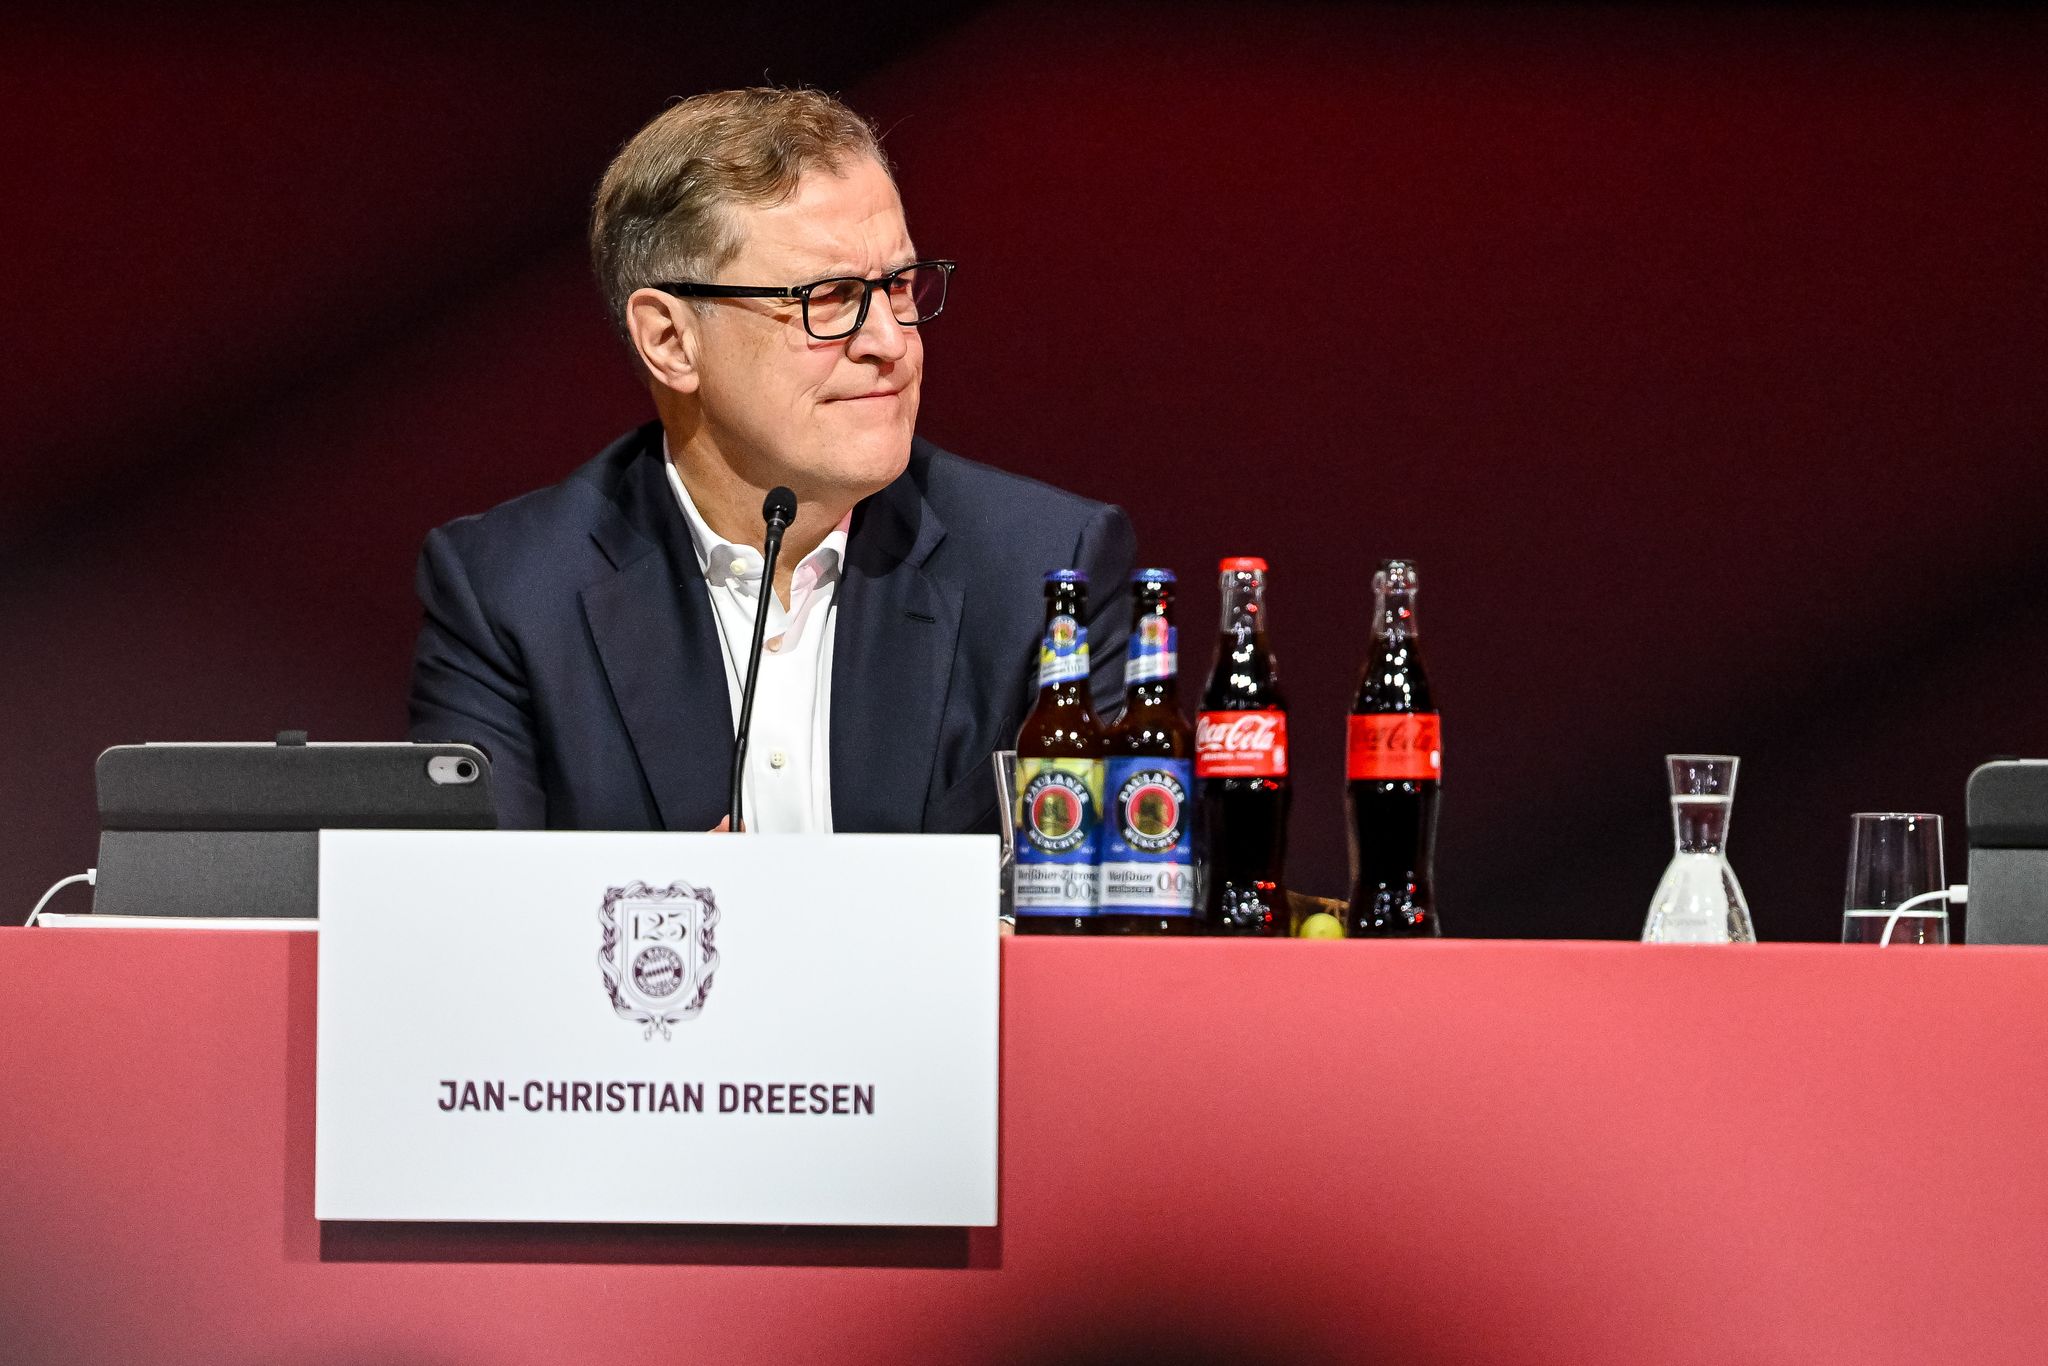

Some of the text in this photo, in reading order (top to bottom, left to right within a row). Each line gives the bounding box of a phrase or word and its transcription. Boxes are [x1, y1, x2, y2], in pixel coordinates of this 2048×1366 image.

[632, 912, 687, 941] 125
[438, 1080, 875, 1115] JAN-CHRISTIAN DREESEN
